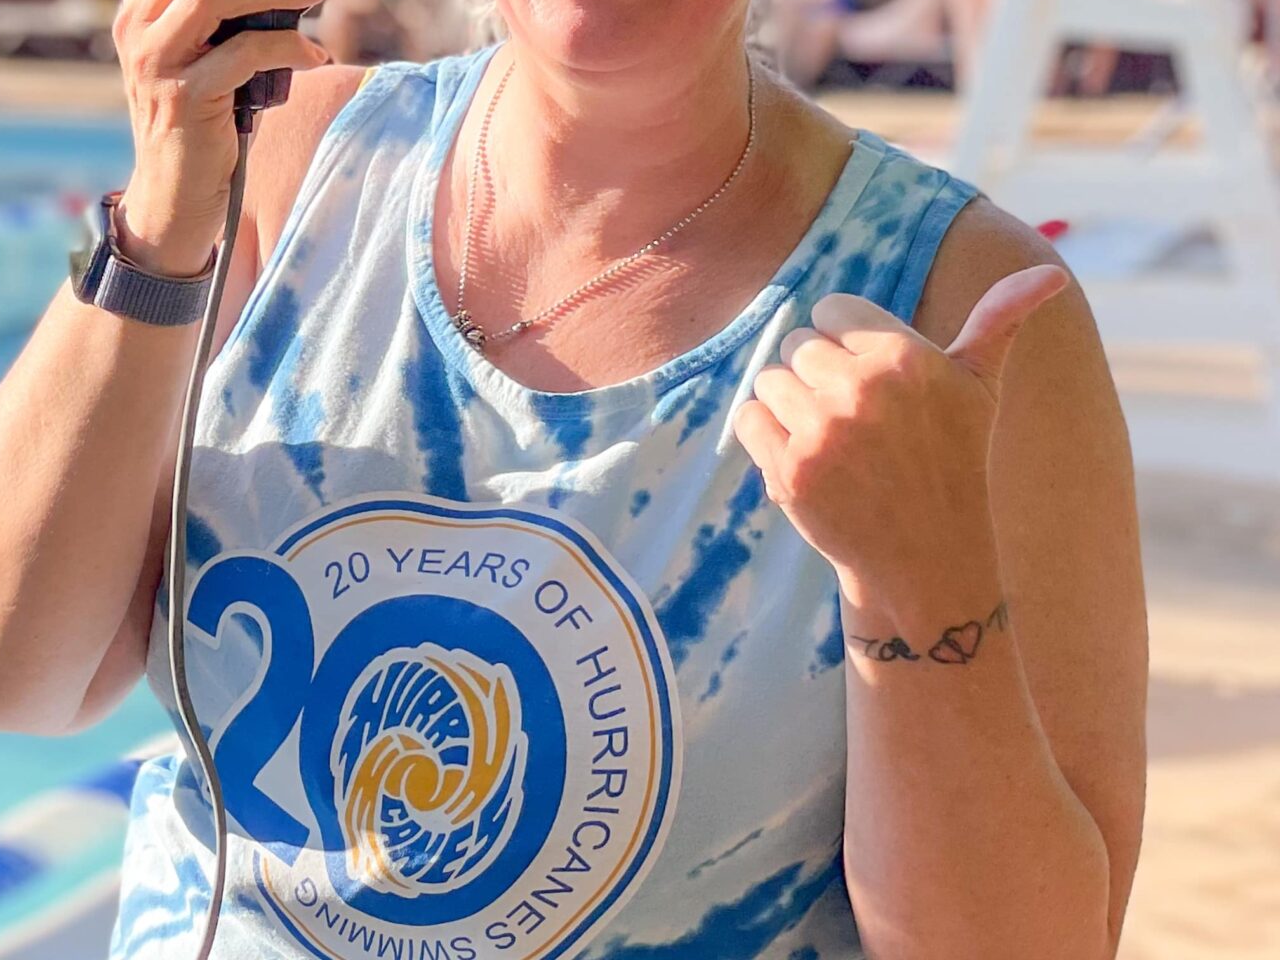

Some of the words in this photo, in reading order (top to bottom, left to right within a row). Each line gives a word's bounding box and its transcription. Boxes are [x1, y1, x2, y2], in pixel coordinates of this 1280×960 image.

[324, 551, 370, 600] 20
[386, 548, 530, 589] YEARS
[534, 579, 594, 631] OF
[186, 555, 568, 927] 20
[485, 645, 629, 950] HURRICANES
[294, 877, 477, 960] SWIMMING
